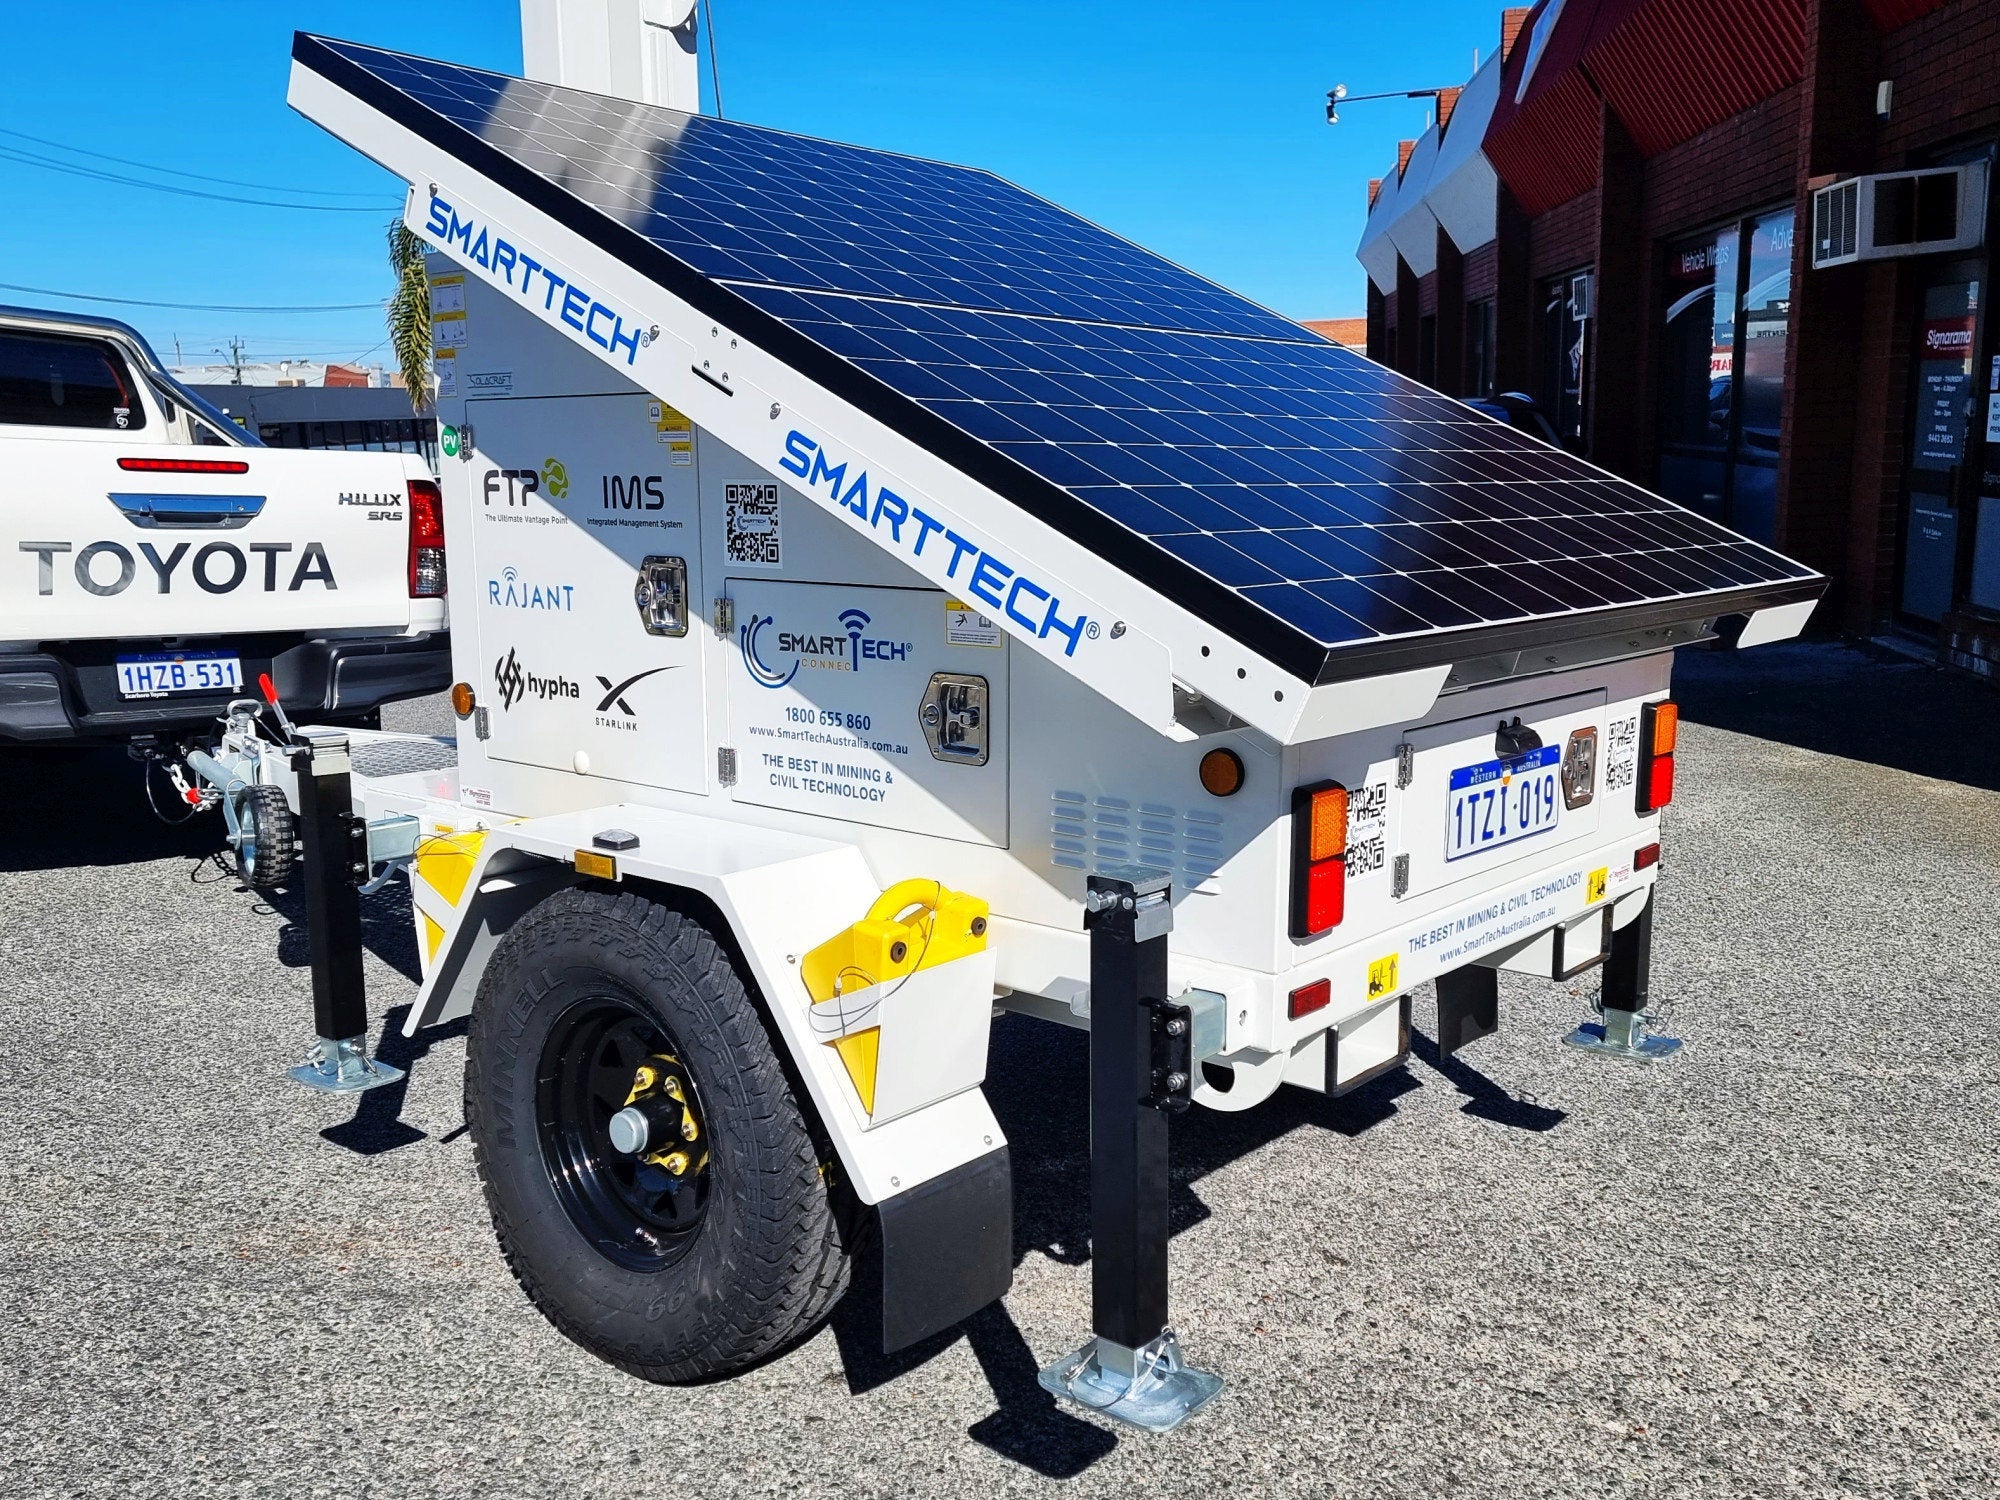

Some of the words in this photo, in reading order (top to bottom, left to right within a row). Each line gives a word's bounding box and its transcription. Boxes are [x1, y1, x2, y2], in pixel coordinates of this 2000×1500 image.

[1682, 248, 1706, 273] Vehicle
[1706, 244, 1730, 270] Wraps
[1927, 329, 1972, 349] Signarama
[443, 435, 457, 446] PV
[338, 492, 402, 508] HILUX
[483, 469, 540, 507] FTP
[603, 475, 665, 510] IMS
[485, 514, 497, 522] The
[497, 514, 523, 524] Ultimate
[524, 515, 551, 525] Vantage
[551, 516, 569, 525] Point
[586, 517, 618, 528] Integrated
[618, 518, 660, 529] Management
[660, 519, 683, 530] System
[19, 541, 338, 597] TOYOTA
[527, 671, 580, 700] hypha
[595, 717, 638, 731] STARLINK
[785, 706, 815, 724] 1800
[819, 710, 842, 726] 655
[846, 713, 871, 730] 860
[749, 726, 908, 755] www.SmartTechAustralia.com.au
[762, 753, 784, 768] THE
[788, 757, 818, 773] BEST
[822, 761, 833, 775] IN
[836, 763, 881, 782] MINING
[885, 771, 893, 784] &
[1470, 770, 1497, 784] WESTERN
[1516, 760, 1541, 773] AUSTRALIA
[769, 773, 799, 789] CIVIL
[802, 777, 886, 802] TECHNOLOGY
[1408, 935, 1427, 953] THE
[1429, 922, 1454, 945] BEST
[1455, 917, 1466, 935] IN
[1467, 905, 1498, 929] MINING
[1500, 902, 1506, 915] &
[1508, 893, 1529, 912] CIVIL
[1531, 871, 1583, 902] TECHNOLOGY
[1439, 906, 1556, 963] www.SmartTechAustralia.com.au
